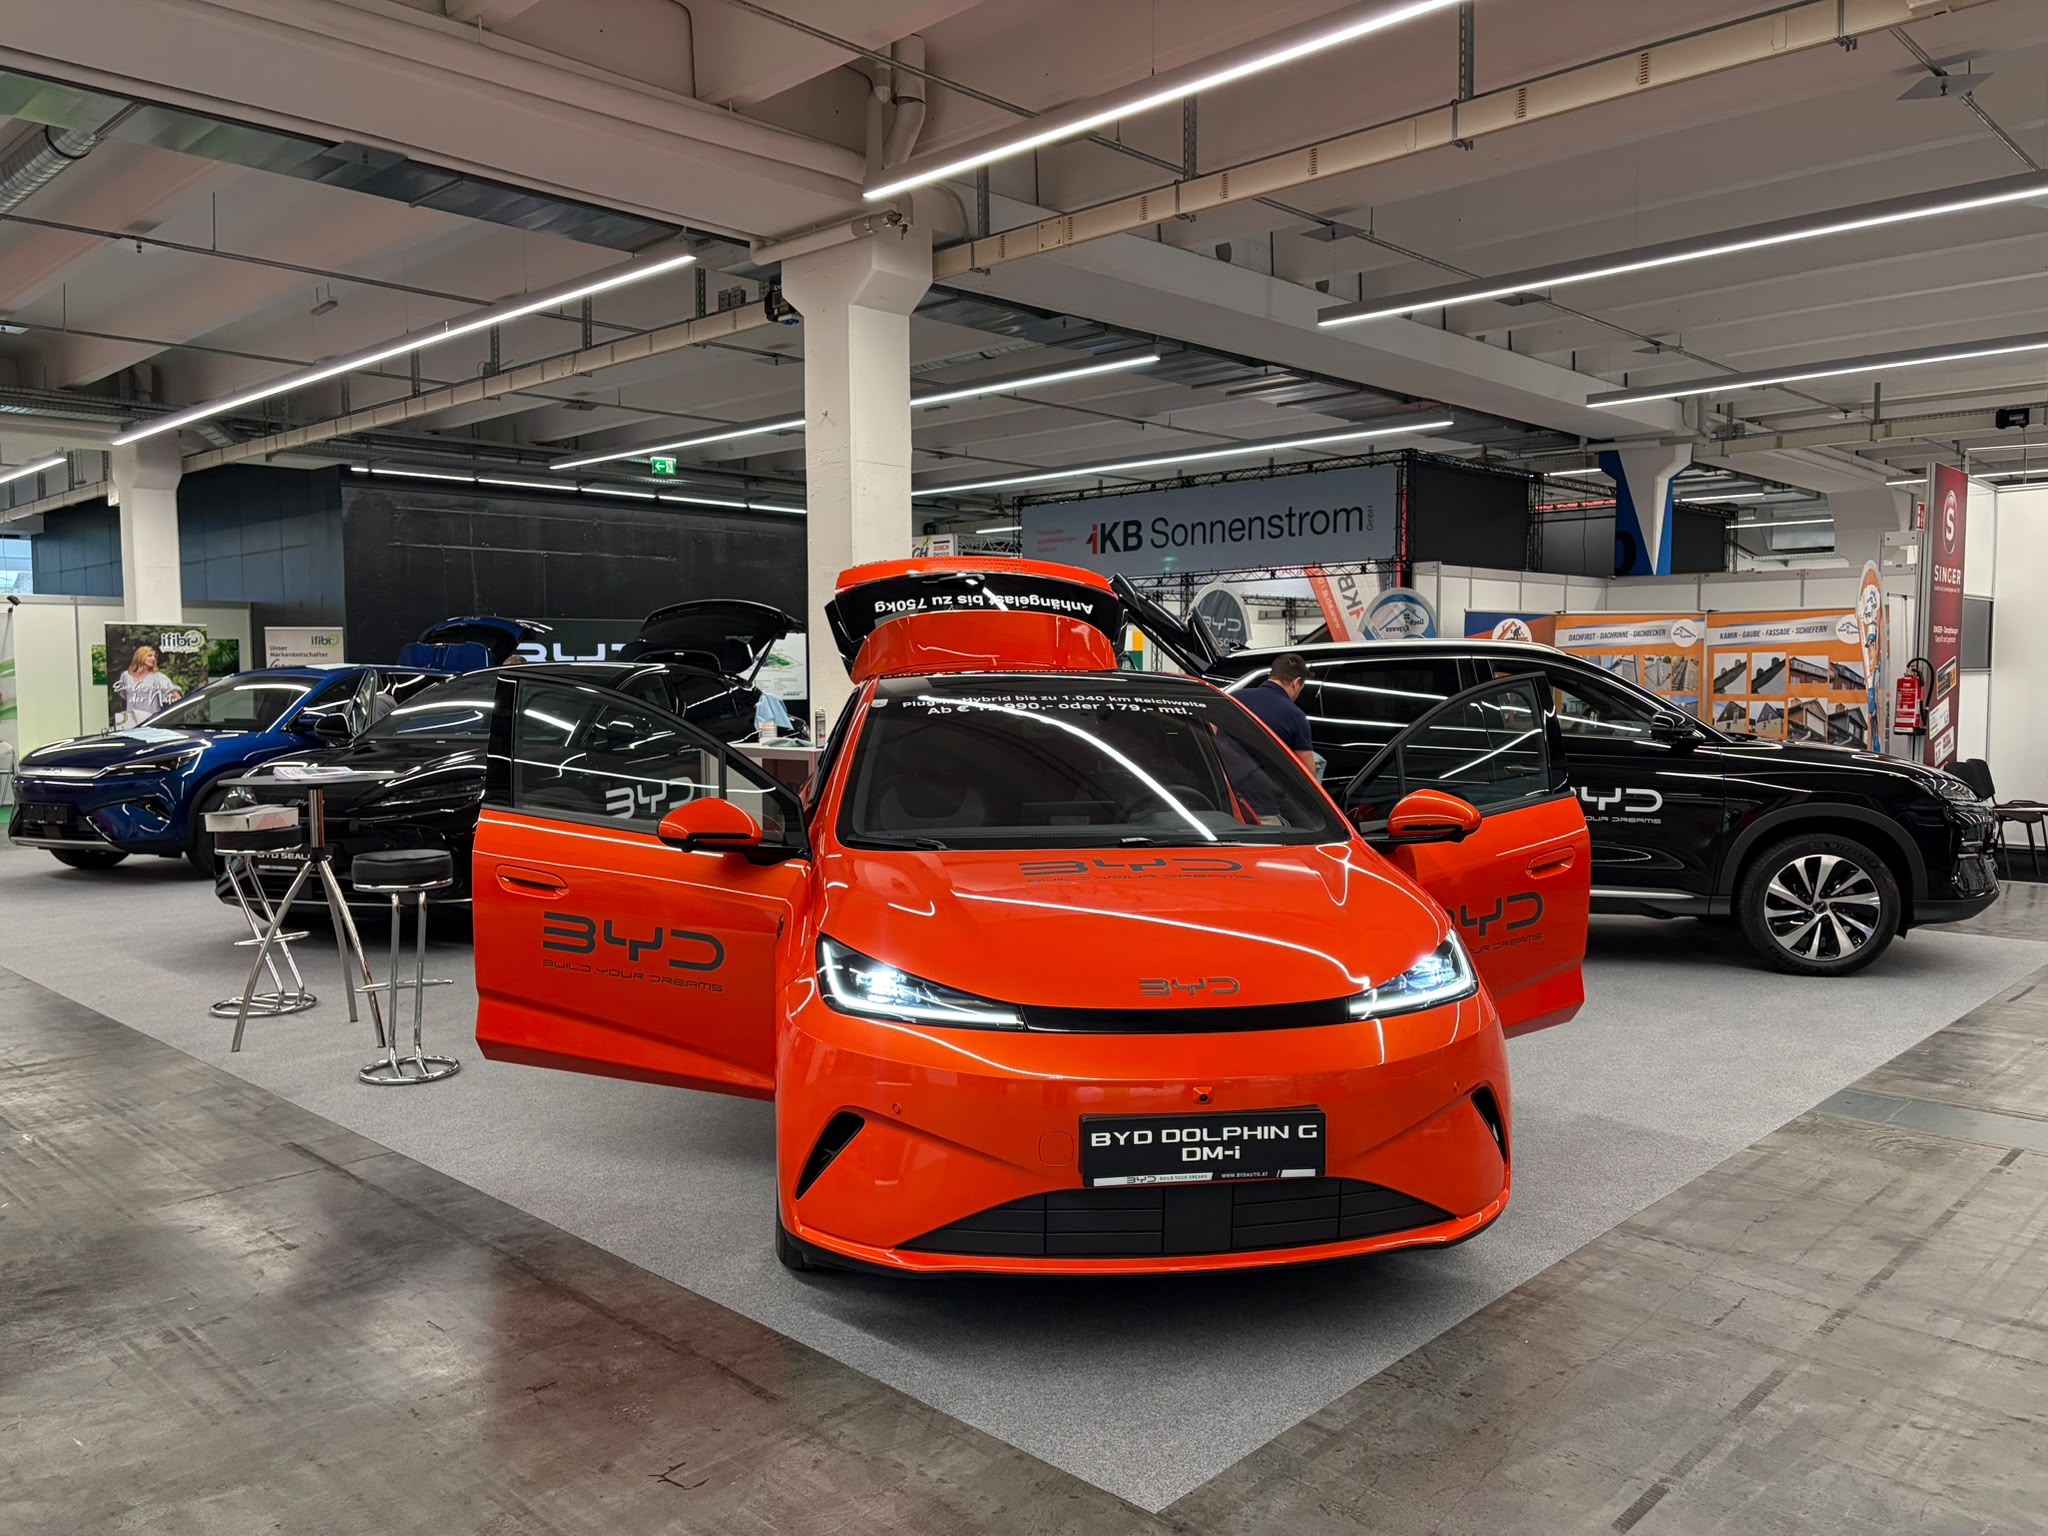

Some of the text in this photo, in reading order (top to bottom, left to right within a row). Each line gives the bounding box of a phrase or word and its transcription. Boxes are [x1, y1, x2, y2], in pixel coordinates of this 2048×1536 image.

[1150, 506, 1364, 549] Sonnenstrom
[1934, 565, 1962, 585] SINGER
[874, 597, 927, 612] 750kg
[932, 595, 953, 606] zu
[958, 595, 984, 606] bis
[1568, 633, 1596, 641] DACHFIRST
[1719, 632, 1738, 640] KAMIN
[1765, 628, 1791, 637] FASSADE
[1795, 625, 1829, 634] SCHIEFERN
[927, 705, 952, 715] Ab
[1058, 702, 1100, 710] oder
[1105, 703, 1154, 713] 179,-
[1158, 706, 1193, 715] mtl.
[1134, 697, 1208, 708] Reichweite
[605, 777, 695, 819] BYD
[1570, 786, 1663, 813] YD
[1018, 858, 1243, 876] BYD
[1446, 891, 1544, 937] YD
[543, 911, 725, 972] BYD
[1492, 932, 1543, 949] DREAMS
[543, 959, 724, 992] BUILD YOUR DREAMS
[1139, 976, 1241, 996] BYD
[1091, 1124, 1318, 1147] BYD DOLPHIN G
[1181, 1146, 1241, 1162] DM-i
[1126, 1175, 1157, 1184] BYD
